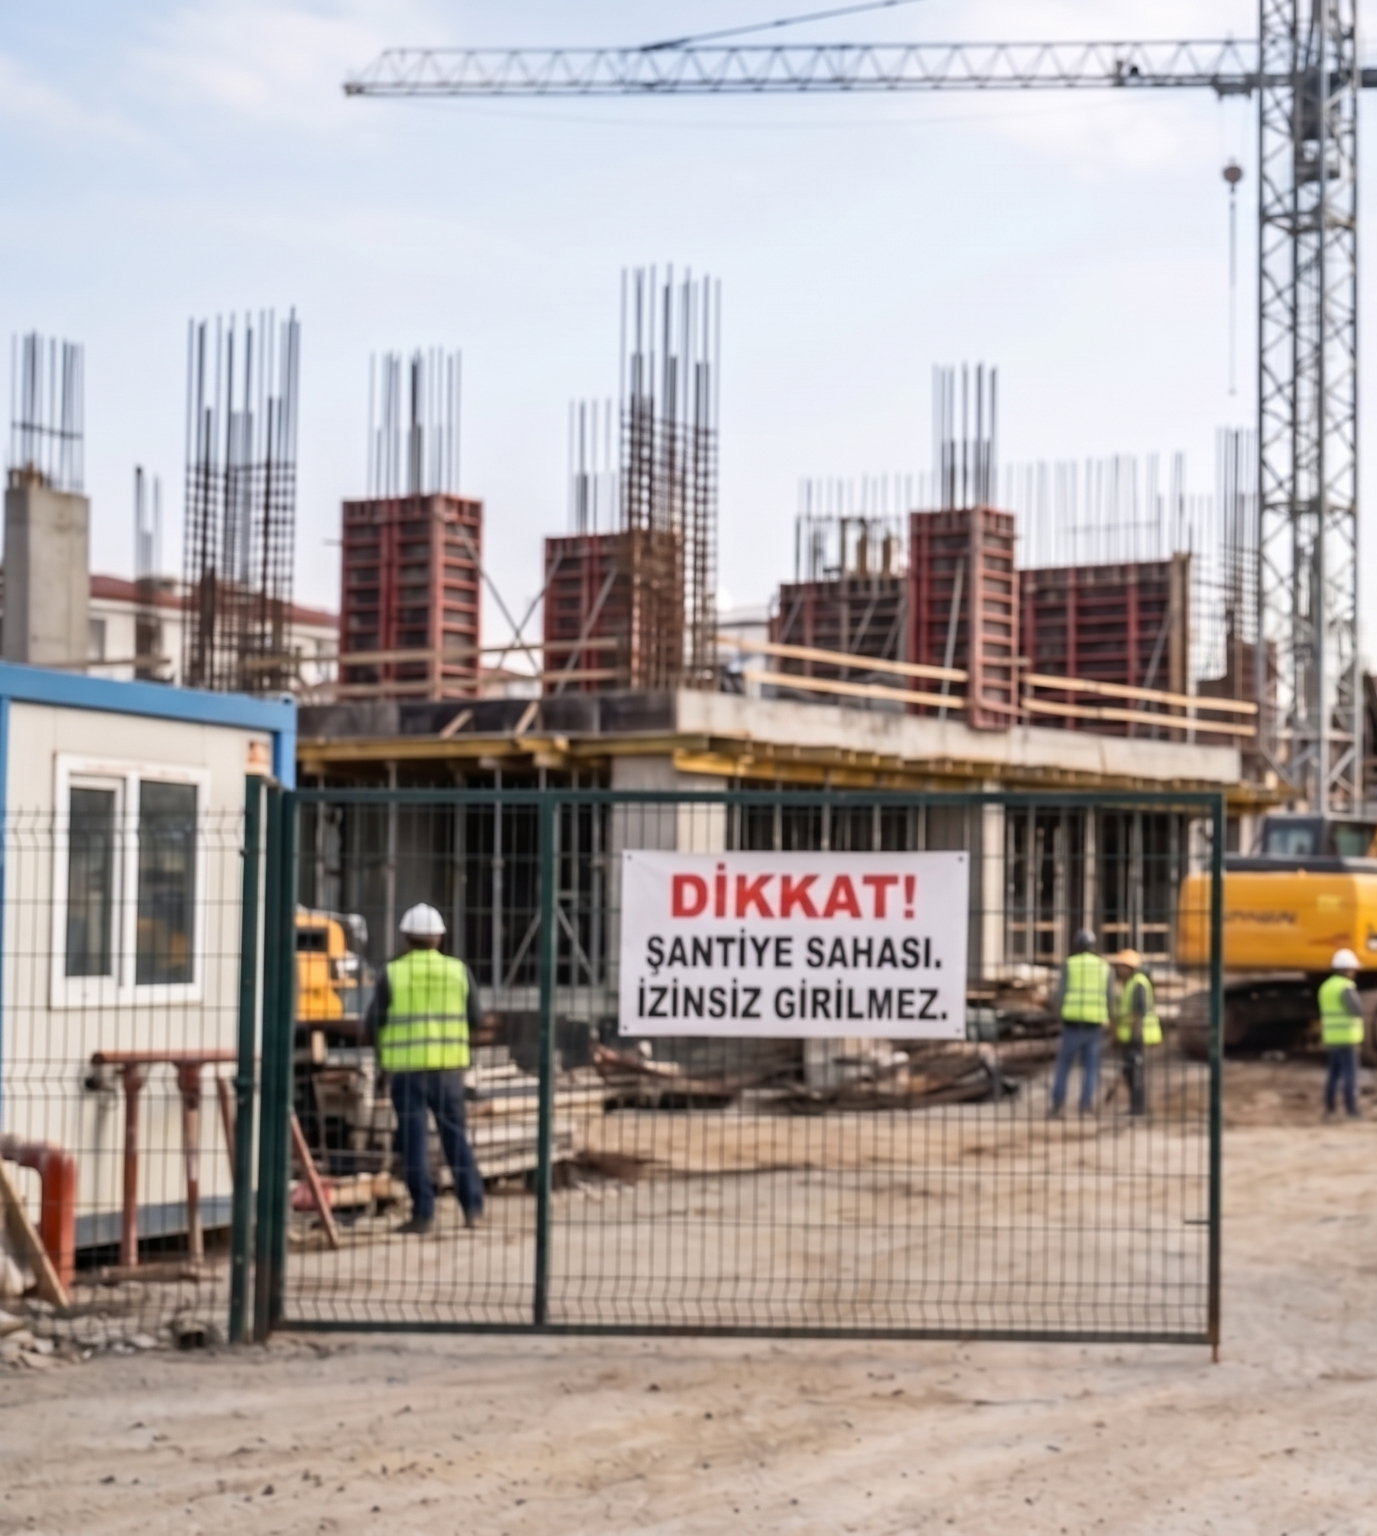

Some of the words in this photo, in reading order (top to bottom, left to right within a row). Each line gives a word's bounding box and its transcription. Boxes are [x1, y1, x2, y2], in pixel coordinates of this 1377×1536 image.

[671, 862, 916, 919] DİKKAT!
[646, 927, 793, 975] ŞANTİYE
[806, 936, 942, 969] SAHASI.
[638, 977, 761, 1019] İZİNSİZ
[774, 978, 948, 1021] GİRİLMEZ.
